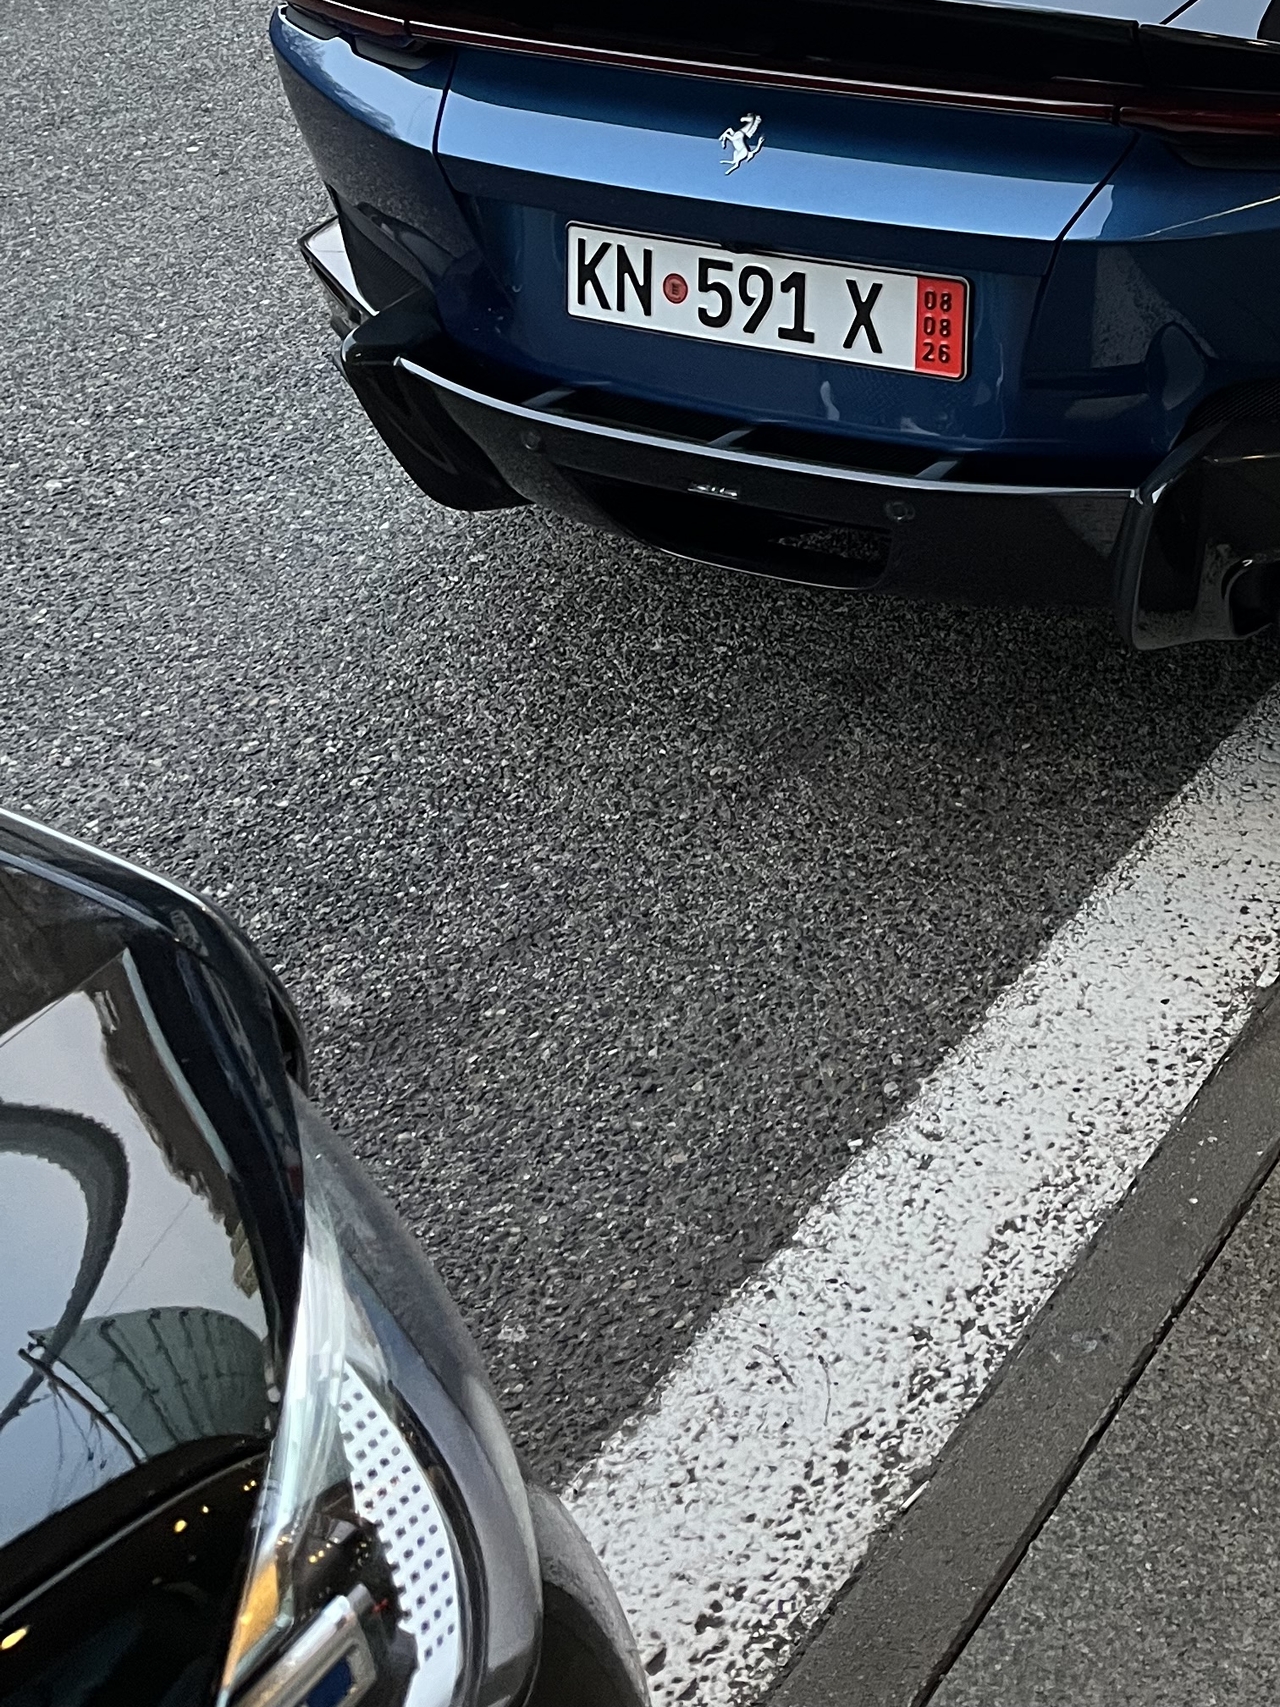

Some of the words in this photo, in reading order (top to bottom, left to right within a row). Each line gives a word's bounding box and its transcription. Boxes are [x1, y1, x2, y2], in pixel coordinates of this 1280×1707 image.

[576, 238, 653, 317] KN
[697, 256, 816, 344] 591
[842, 279, 884, 354] X
[924, 290, 952, 312] 08
[923, 316, 951, 338] 08
[921, 342, 951, 364] 26
